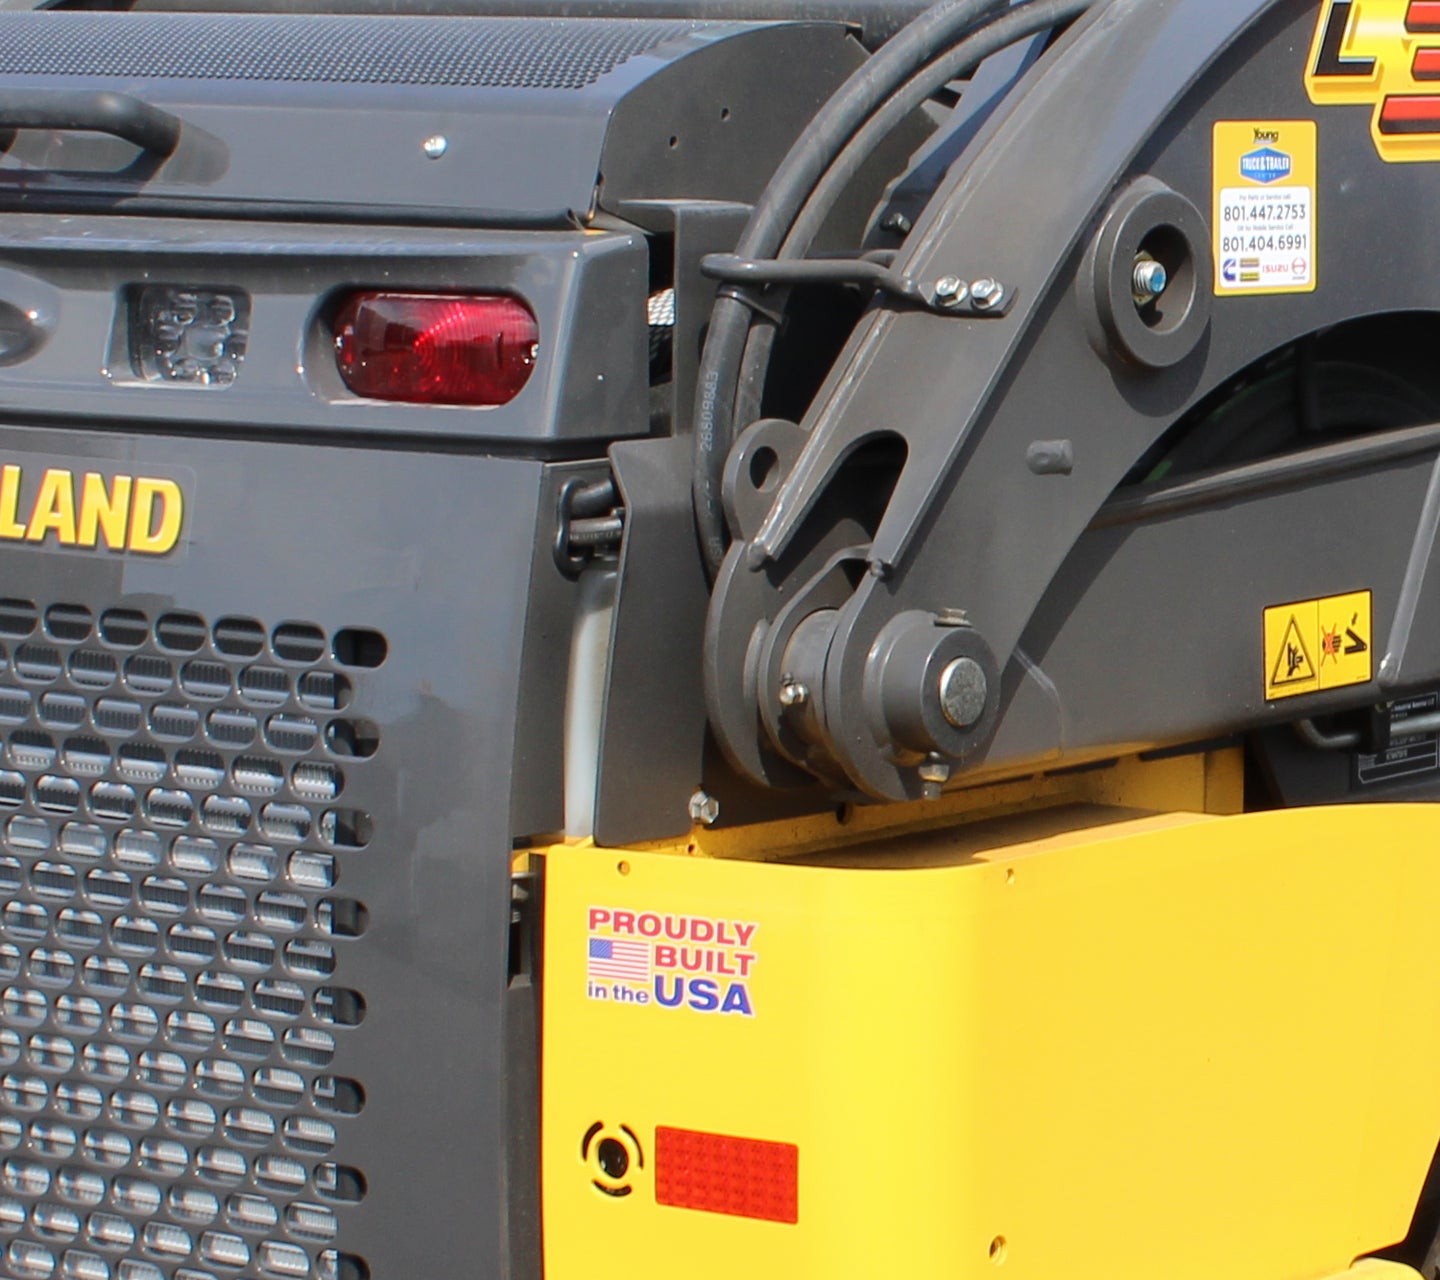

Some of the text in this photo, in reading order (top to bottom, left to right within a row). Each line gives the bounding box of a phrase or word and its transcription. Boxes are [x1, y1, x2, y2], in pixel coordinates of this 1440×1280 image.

[1253, 127, 1279, 144] Young
[1224, 204, 1306, 221] 801.447.2753
[1222, 233, 1307, 252] 801.404.6991
[1262, 264, 1289, 273] ISUZU
[588, 907, 757, 947] PROUDLY
[654, 944, 756, 977] BUILT
[587, 974, 753, 1016] in the USA
